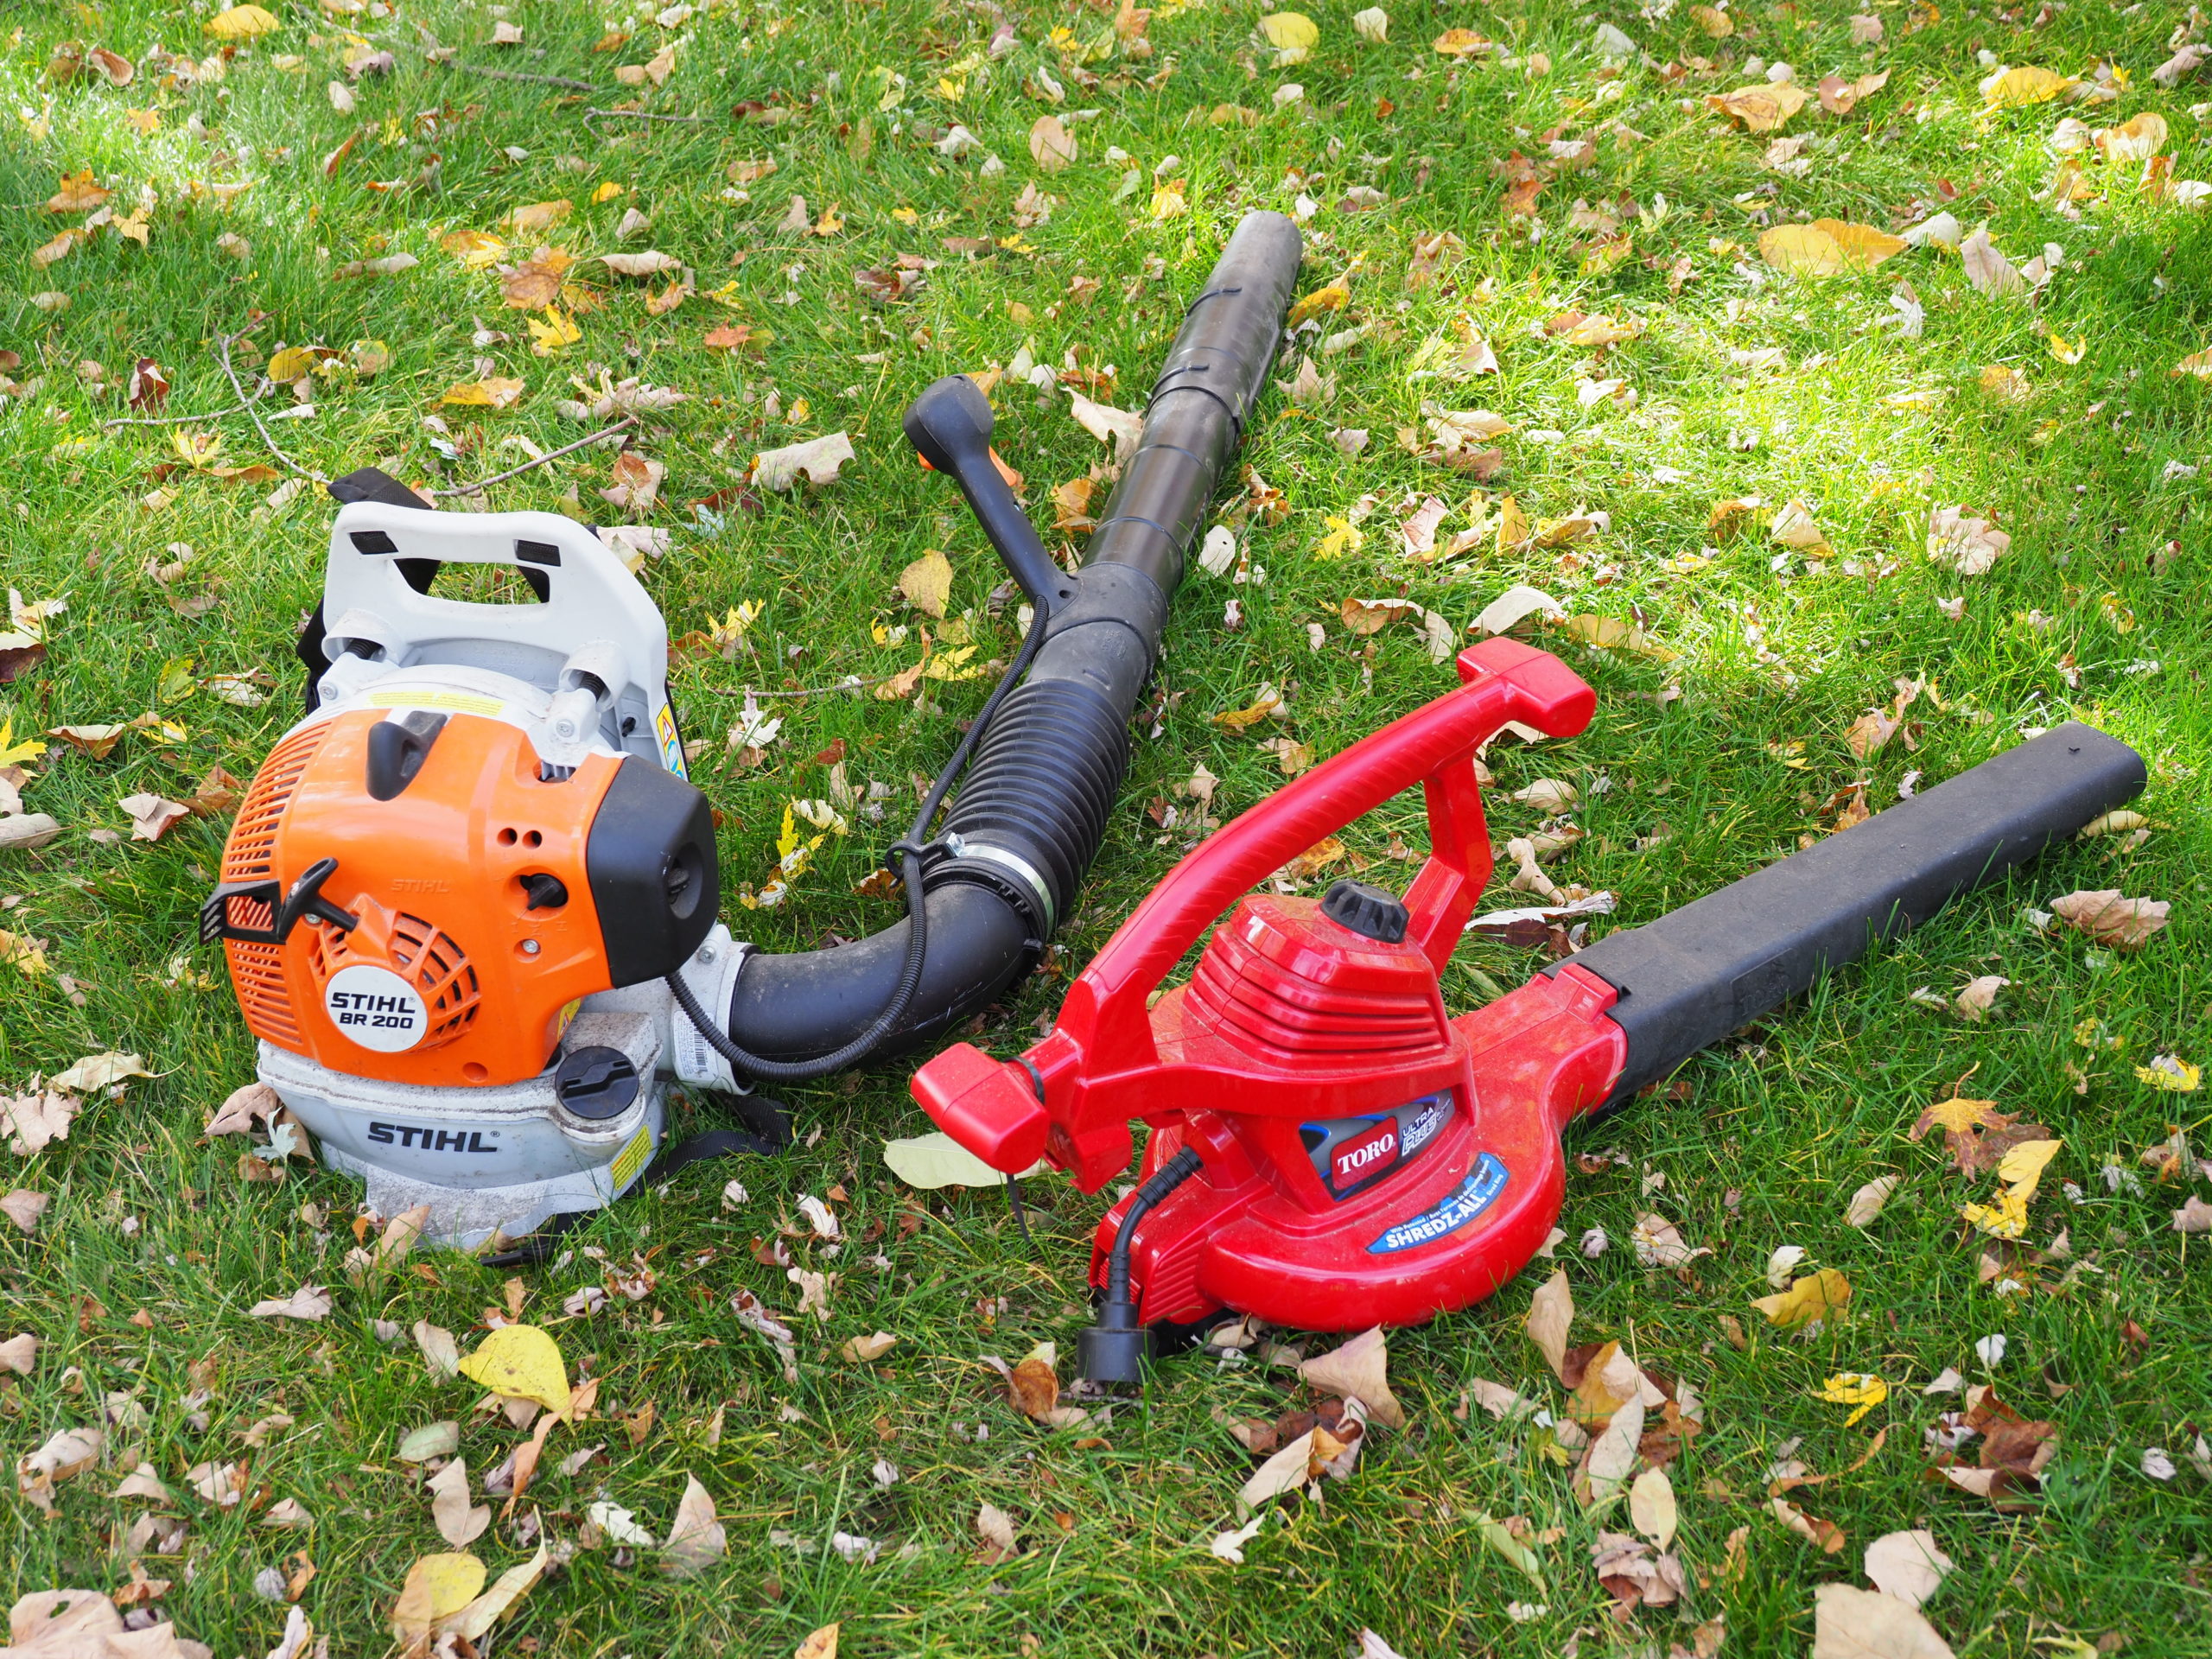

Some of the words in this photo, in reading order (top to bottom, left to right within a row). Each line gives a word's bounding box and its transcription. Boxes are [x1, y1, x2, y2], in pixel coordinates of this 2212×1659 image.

[330, 991, 416, 1014] STIHL
[339, 1012, 367, 1026] BR
[372, 1014, 414, 1029] 200
[367, 1121, 498, 1153] STIHL
[1402, 1107, 1434, 1137] ULTRA
[1402, 1111, 1437, 1157] PLUS
[1337, 1133, 1394, 1174] TORO
[1385, 1193, 1487, 1249] SHREDZ-ALL
